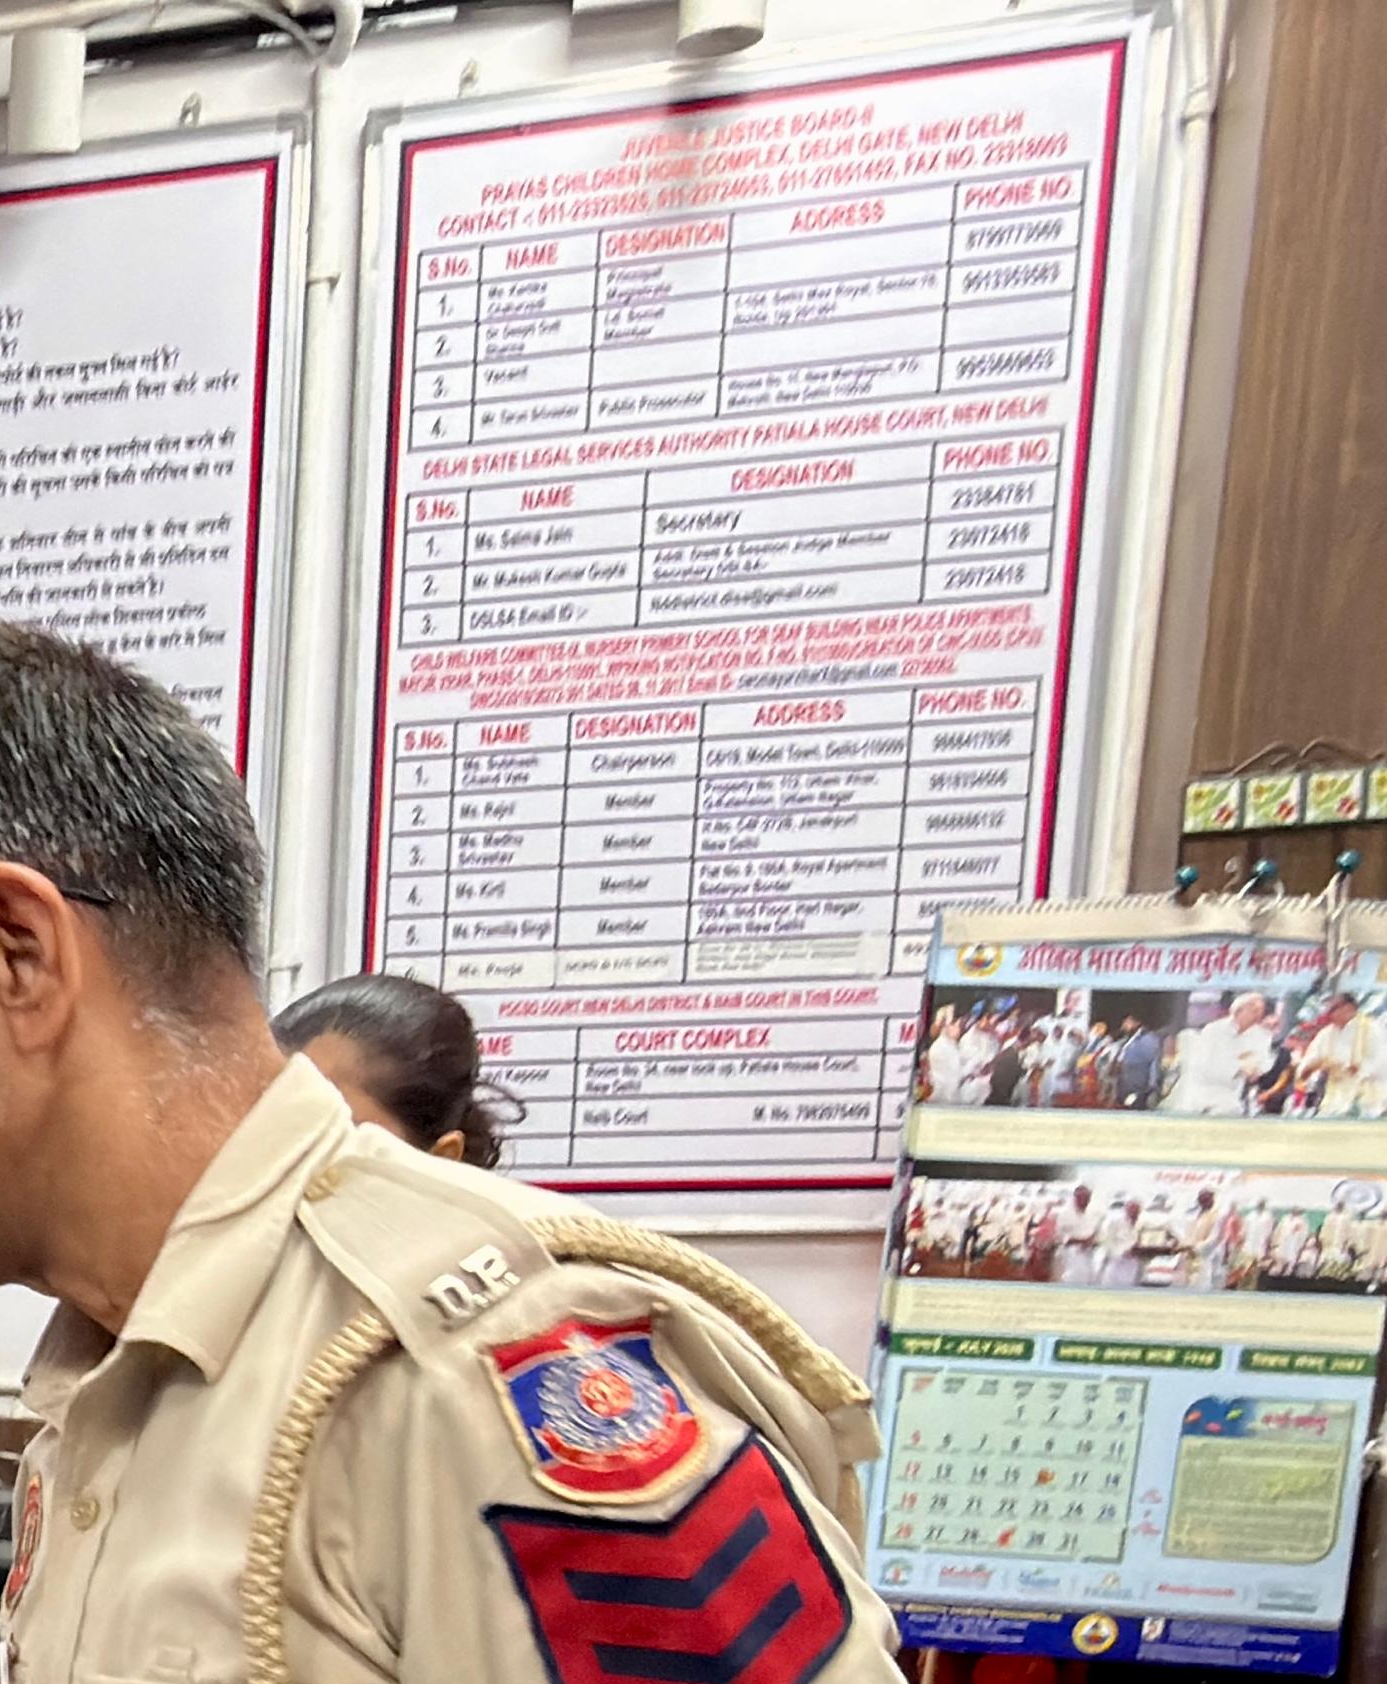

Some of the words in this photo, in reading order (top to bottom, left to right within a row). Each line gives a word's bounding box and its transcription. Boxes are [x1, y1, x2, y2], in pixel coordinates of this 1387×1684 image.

[709, 115, 785, 148] JUSTICE
[481, 173, 548, 205] PRAYAS
[551, 160, 641, 195] CHILDREN
[647, 153, 697, 183] HOME
[798, 132, 853, 163] DELHI
[918, 118, 963, 147] NEW
[966, 109, 1025, 140] DELHI
[439, 204, 517, 238] CONTACT
[904, 150, 940, 178] FAX
[789, 199, 885, 233] ADDRESS
[965, 178, 1034, 211] PHONE
[505, 243, 559, 271] NAME
[605, 223, 726, 258] DESIGNATION
[424, 455, 468, 481] DELHI
[471, 450, 518, 476] STATE
[521, 444, 572, 470] LEGAL
[578, 435, 655, 465] SERVICES
[657, 426, 748, 456] AUTHORITY
[751, 418, 820, 446] PATIALA
[824, 412, 878, 439] HOUSE
[885, 405, 947, 433] COURT,
[952, 400, 992, 426] NEW
[995, 394, 1050, 421] DELHI
[730, 458, 855, 493] DESIGNATION
[943, 442, 1013, 471] PHONE
[520, 486, 575, 511] NAME
[655, 509, 744, 534] Secretary
[480, 722, 532, 745] NAME
[575, 712, 697, 738] DESIGNATION
[753, 699, 847, 728] ADDRESS
[918, 688, 987, 714] PHONE
[614, 1030, 678, 1053] COURT
[681, 1026, 770, 1050] COMPLEX
